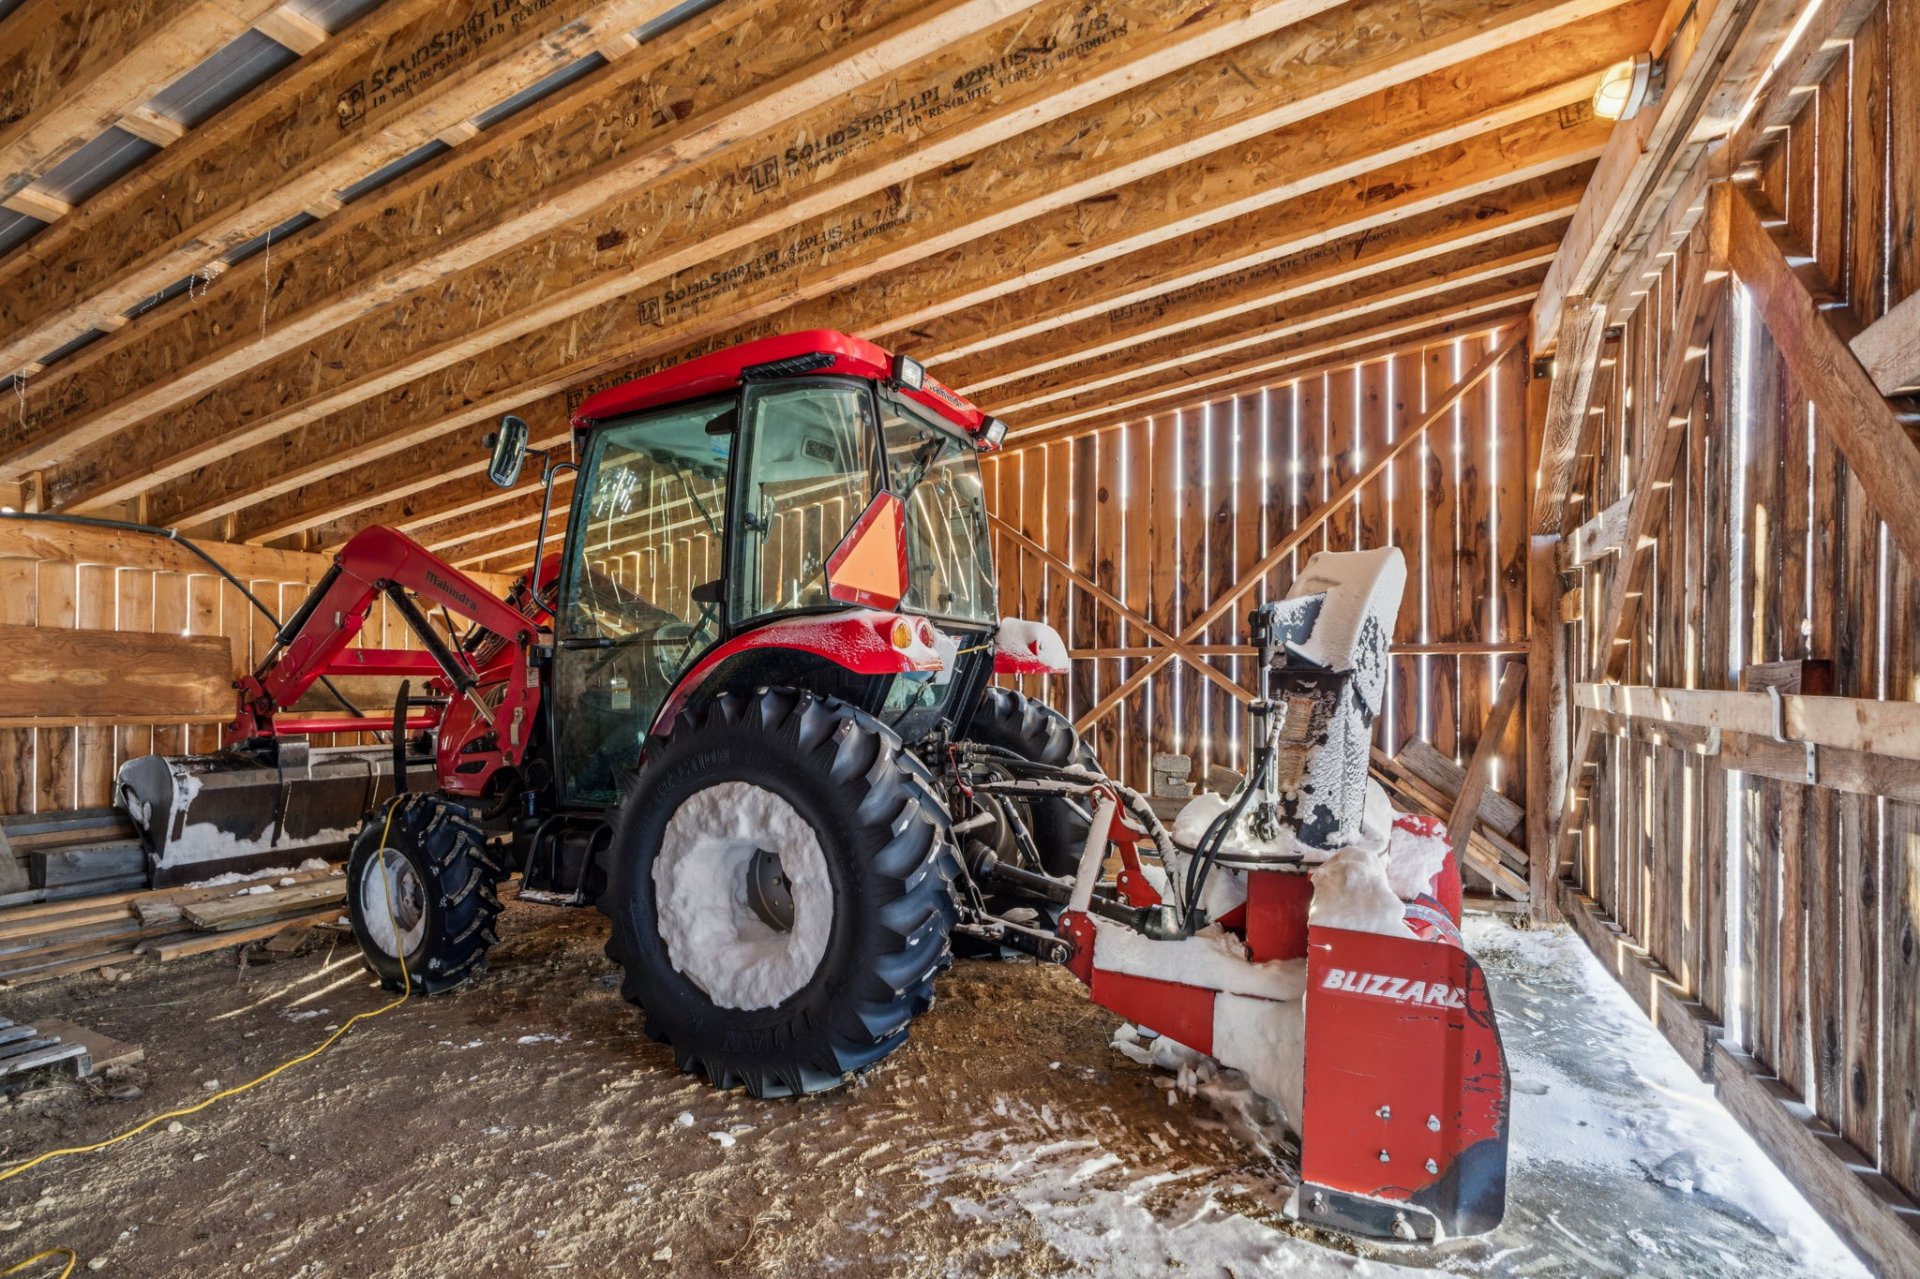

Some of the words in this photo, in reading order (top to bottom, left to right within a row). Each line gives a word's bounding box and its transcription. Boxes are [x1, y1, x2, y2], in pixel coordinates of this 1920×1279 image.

[927, 82, 992, 119] RESOLUTE
[426, 568, 478, 613] Mahindra
[1321, 967, 1467, 1010] BLIZZARD
